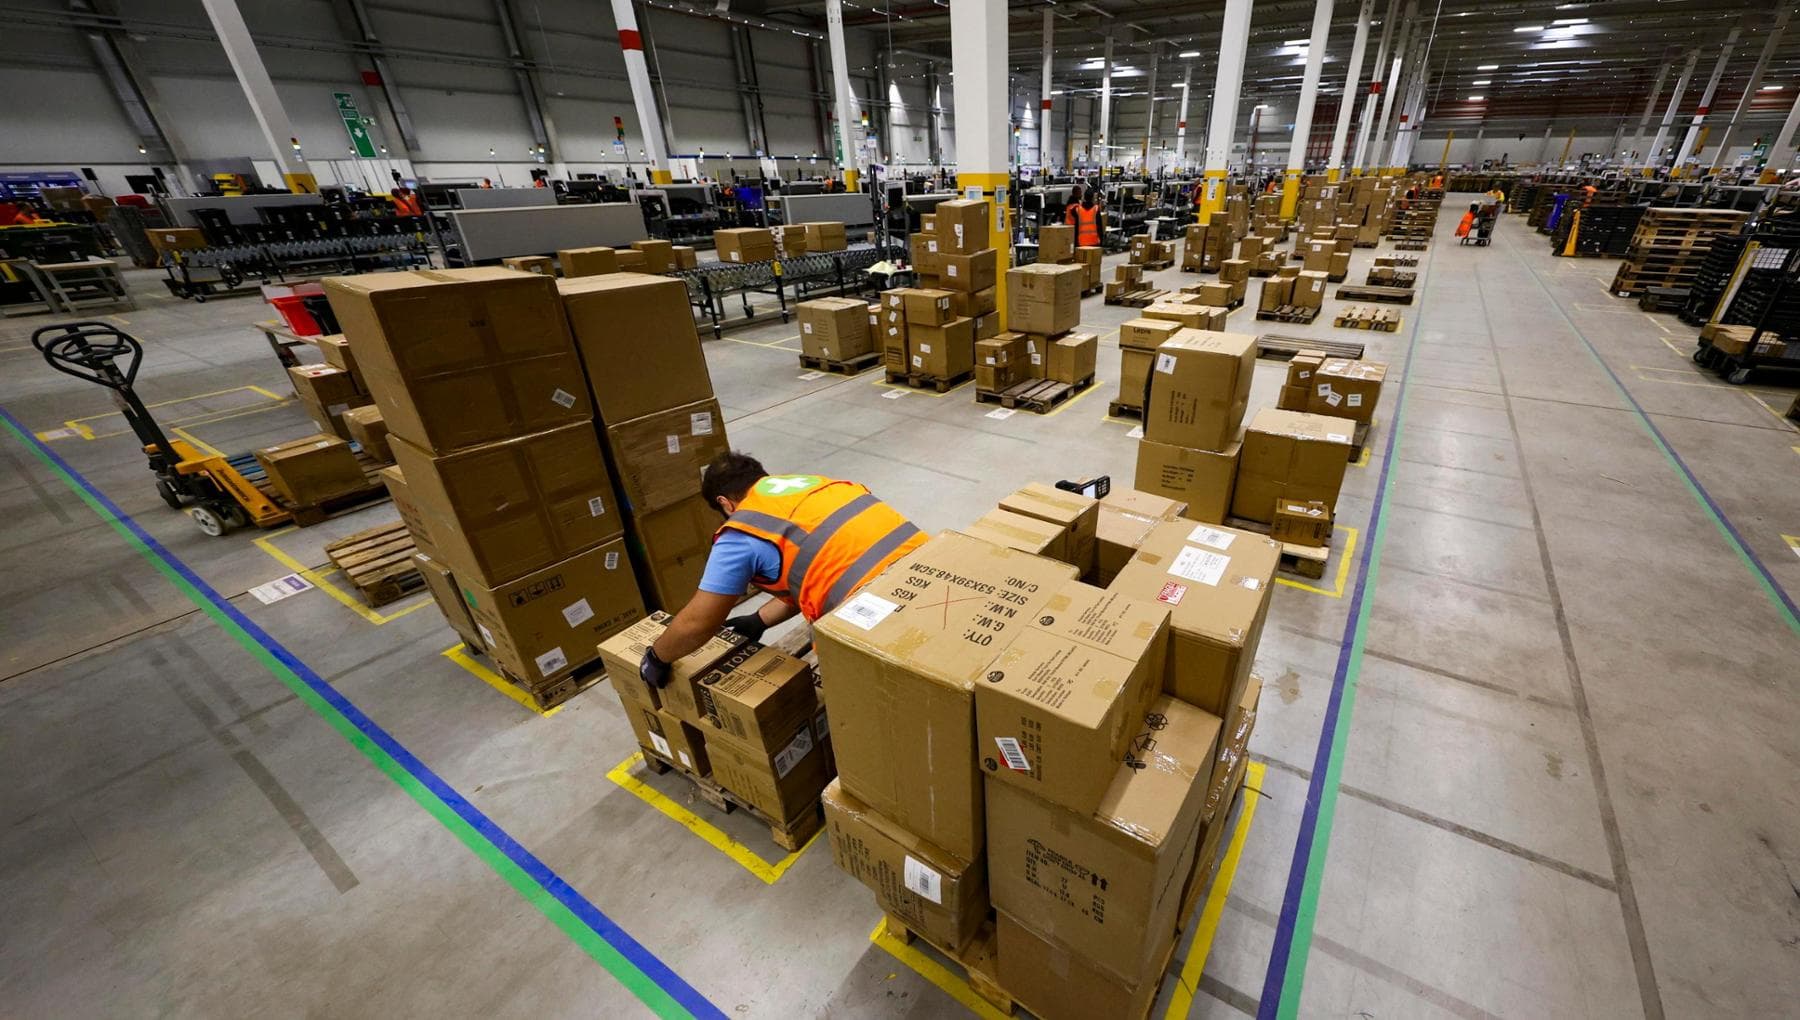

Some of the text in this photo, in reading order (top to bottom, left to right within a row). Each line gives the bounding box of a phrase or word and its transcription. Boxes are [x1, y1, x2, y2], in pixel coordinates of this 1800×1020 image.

[905, 576, 932, 590] KGS
[891, 587, 918, 602] KGS
[999, 589, 1029, 606] SIZE:
[963, 629, 993, 647] QTY:
[724, 645, 758, 669] TOYS
